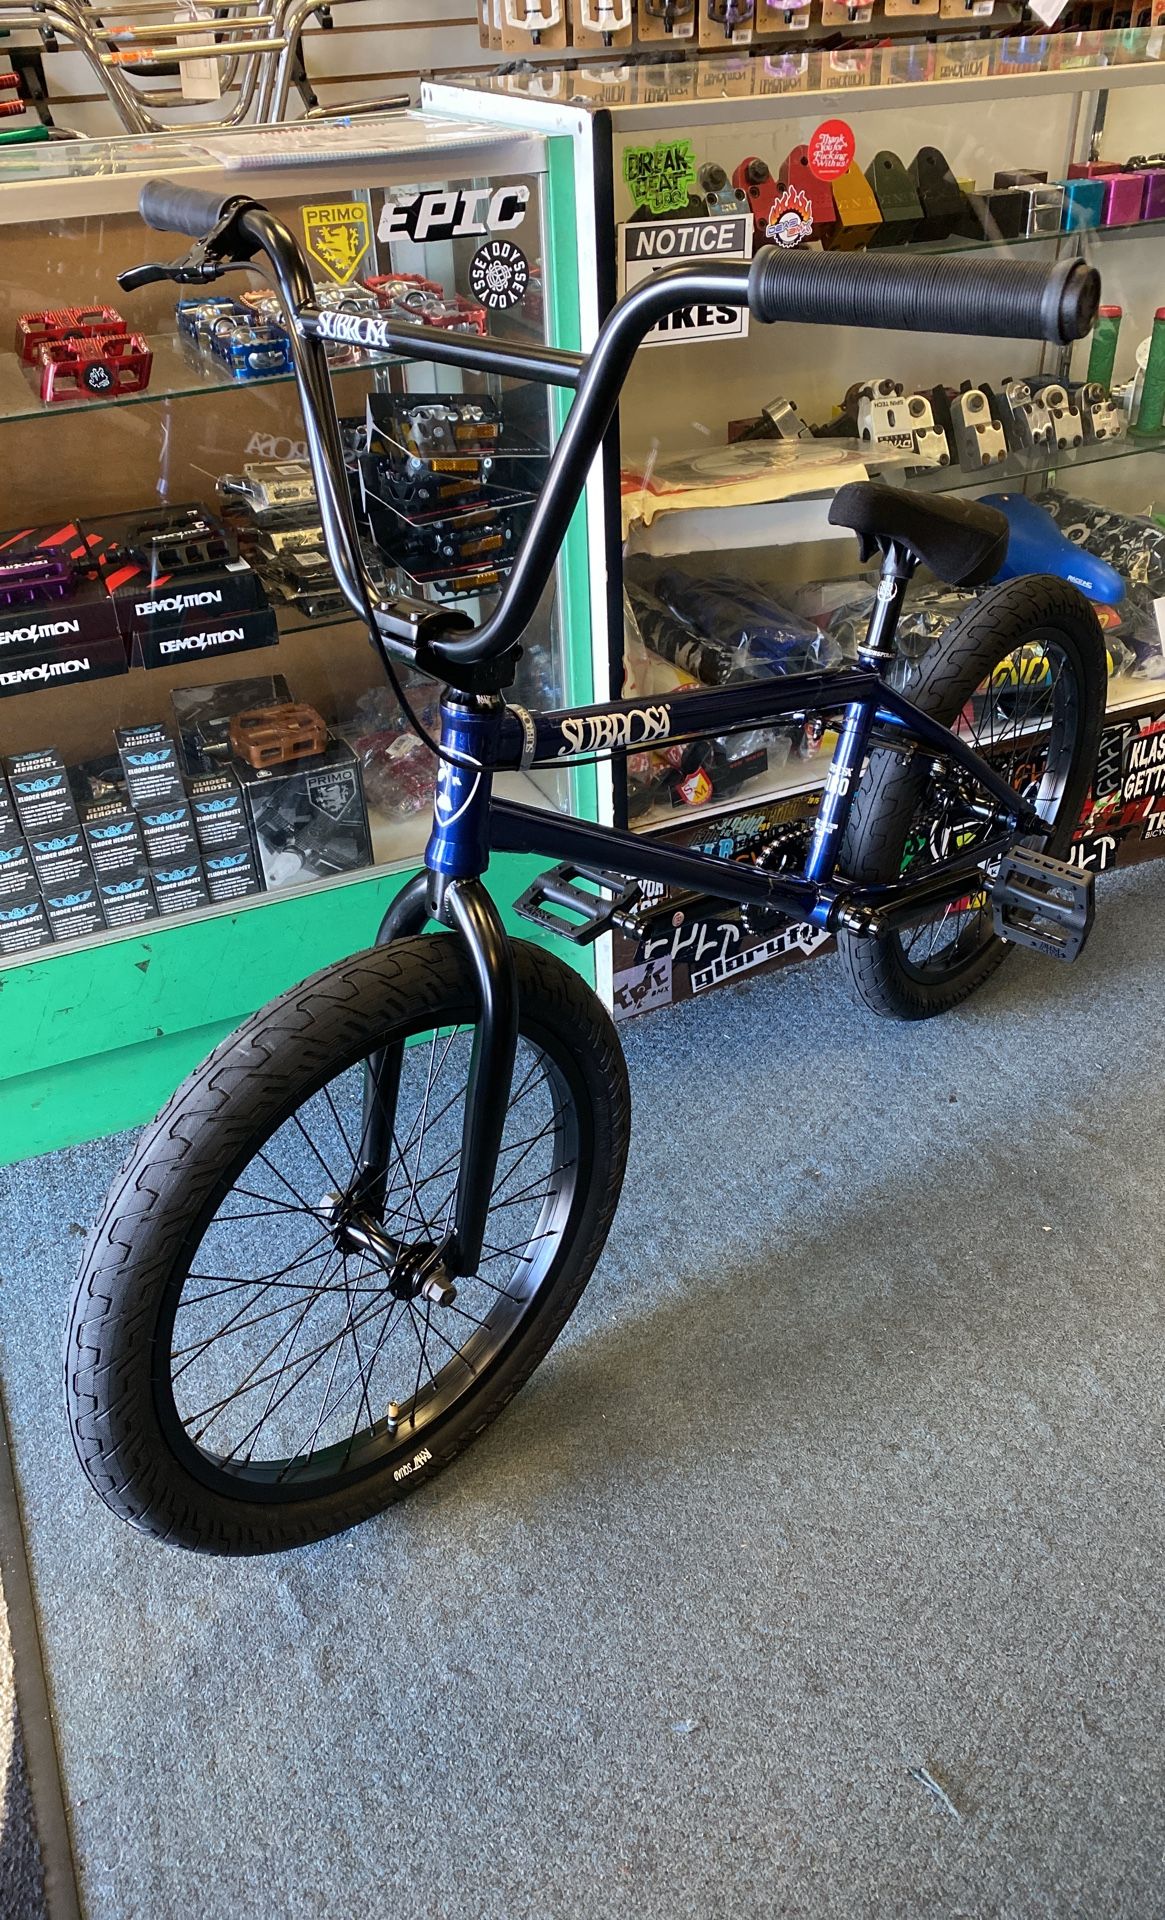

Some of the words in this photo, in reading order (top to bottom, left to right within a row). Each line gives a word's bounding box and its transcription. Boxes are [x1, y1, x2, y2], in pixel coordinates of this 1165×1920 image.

[819, 133, 846, 144] Thank
[812, 150, 848, 161] Fucking
[306, 207, 365, 224] PRIMO
[377, 185, 530, 243] EPIC
[636, 223, 736, 257] NOTICE
[316, 310, 390, 348] SUBROSA
[648, 305, 738, 332] IKES
[134, 590, 222, 617] DEMOLITION
[159, 628, 244, 656] DEMOLITION
[0, 657, 90, 686] DEMOLITION
[557, 704, 671, 757] SUBROSA
[308, 771, 353, 787] PRIMO
[1123, 762, 1165, 803] GETT
